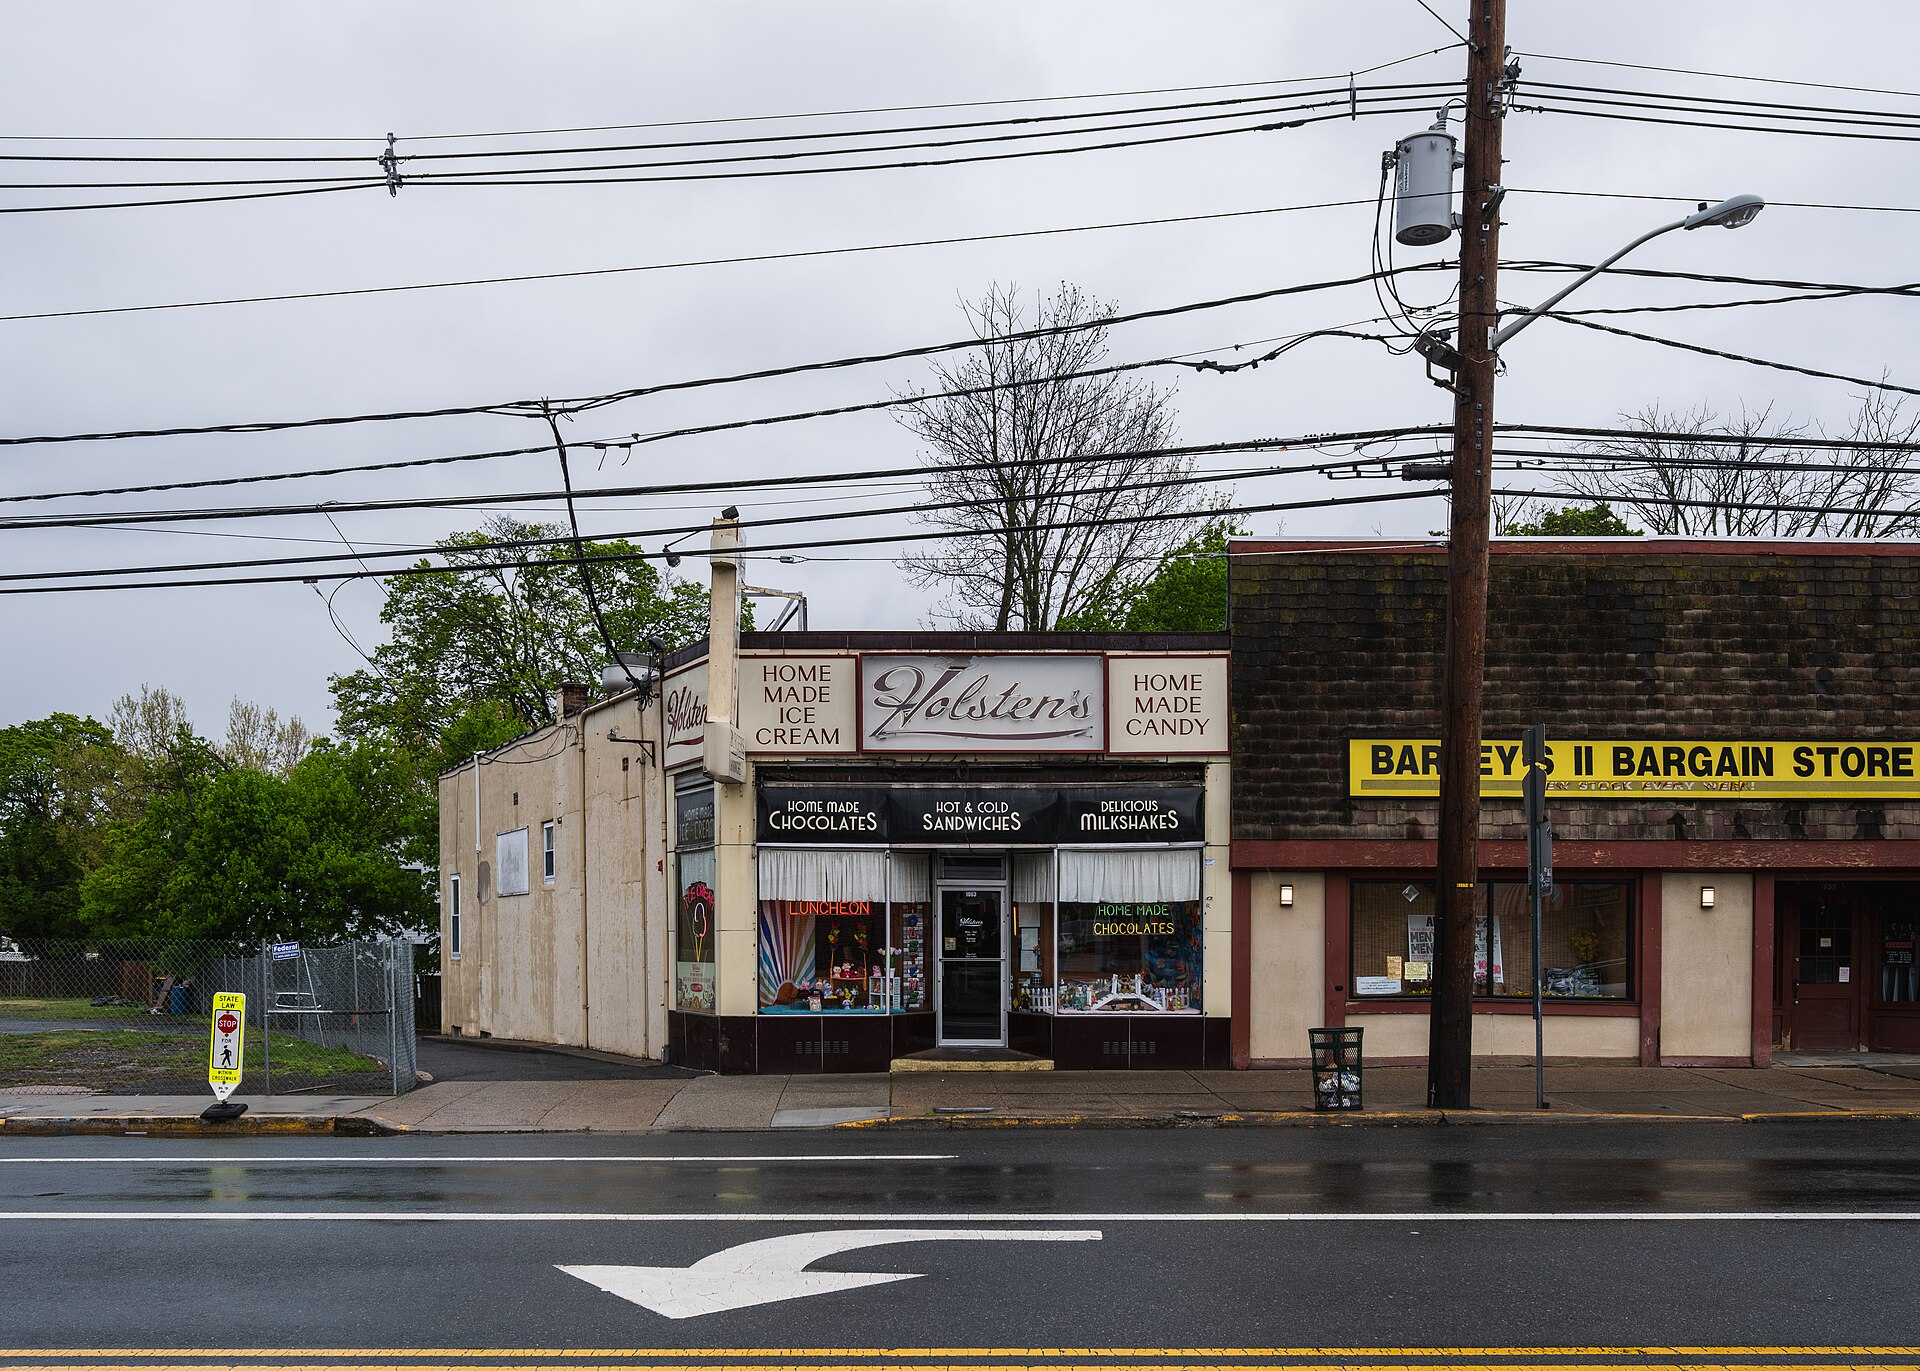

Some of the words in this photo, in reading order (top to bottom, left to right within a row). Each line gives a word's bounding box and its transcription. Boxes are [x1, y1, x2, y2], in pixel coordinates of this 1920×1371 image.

[763, 665, 832, 682] HOME
[1134, 674, 1202, 691] HOME
[763, 686, 831, 703] MADE
[869, 664, 1093, 738] Holsten's
[1135, 696, 1201, 714] MADE
[667, 686, 709, 748] Holsten
[778, 708, 816, 724] ICE
[1126, 719, 1210, 736] CANDY
[755, 728, 840, 745] CREAM
[1574, 745, 1594, 776] II
[1613, 745, 1774, 777] BARGAIN
[1792, 746, 1914, 777] STORE
[1546, 781, 1569, 791] EW
[1579, 781, 1633, 791] STOCK
[1641, 781, 1696, 791] EVERY
[788, 801, 822, 813] HOME
[826, 801, 860, 813] MADE
[936, 802, 959, 814] HOT
[964, 802, 973, 814] &
[977, 802, 1009, 814] COLD
[1101, 800, 1158, 813] DELICIOUS
[769, 810, 878, 832] CHOCOLATES
[923, 811, 1021, 832] SANDWICHES
[1080, 809, 1178, 831] MILKSHAKES
[789, 901, 870, 915] LUNCHEON
[1098, 904, 1132, 916] HOME
[1136, 904, 1169, 916] MADE
[1093, 922, 1175, 935] CHOCOLATES
[273, 944, 298, 953] Federal
[218, 1019, 237, 1028] STOP
